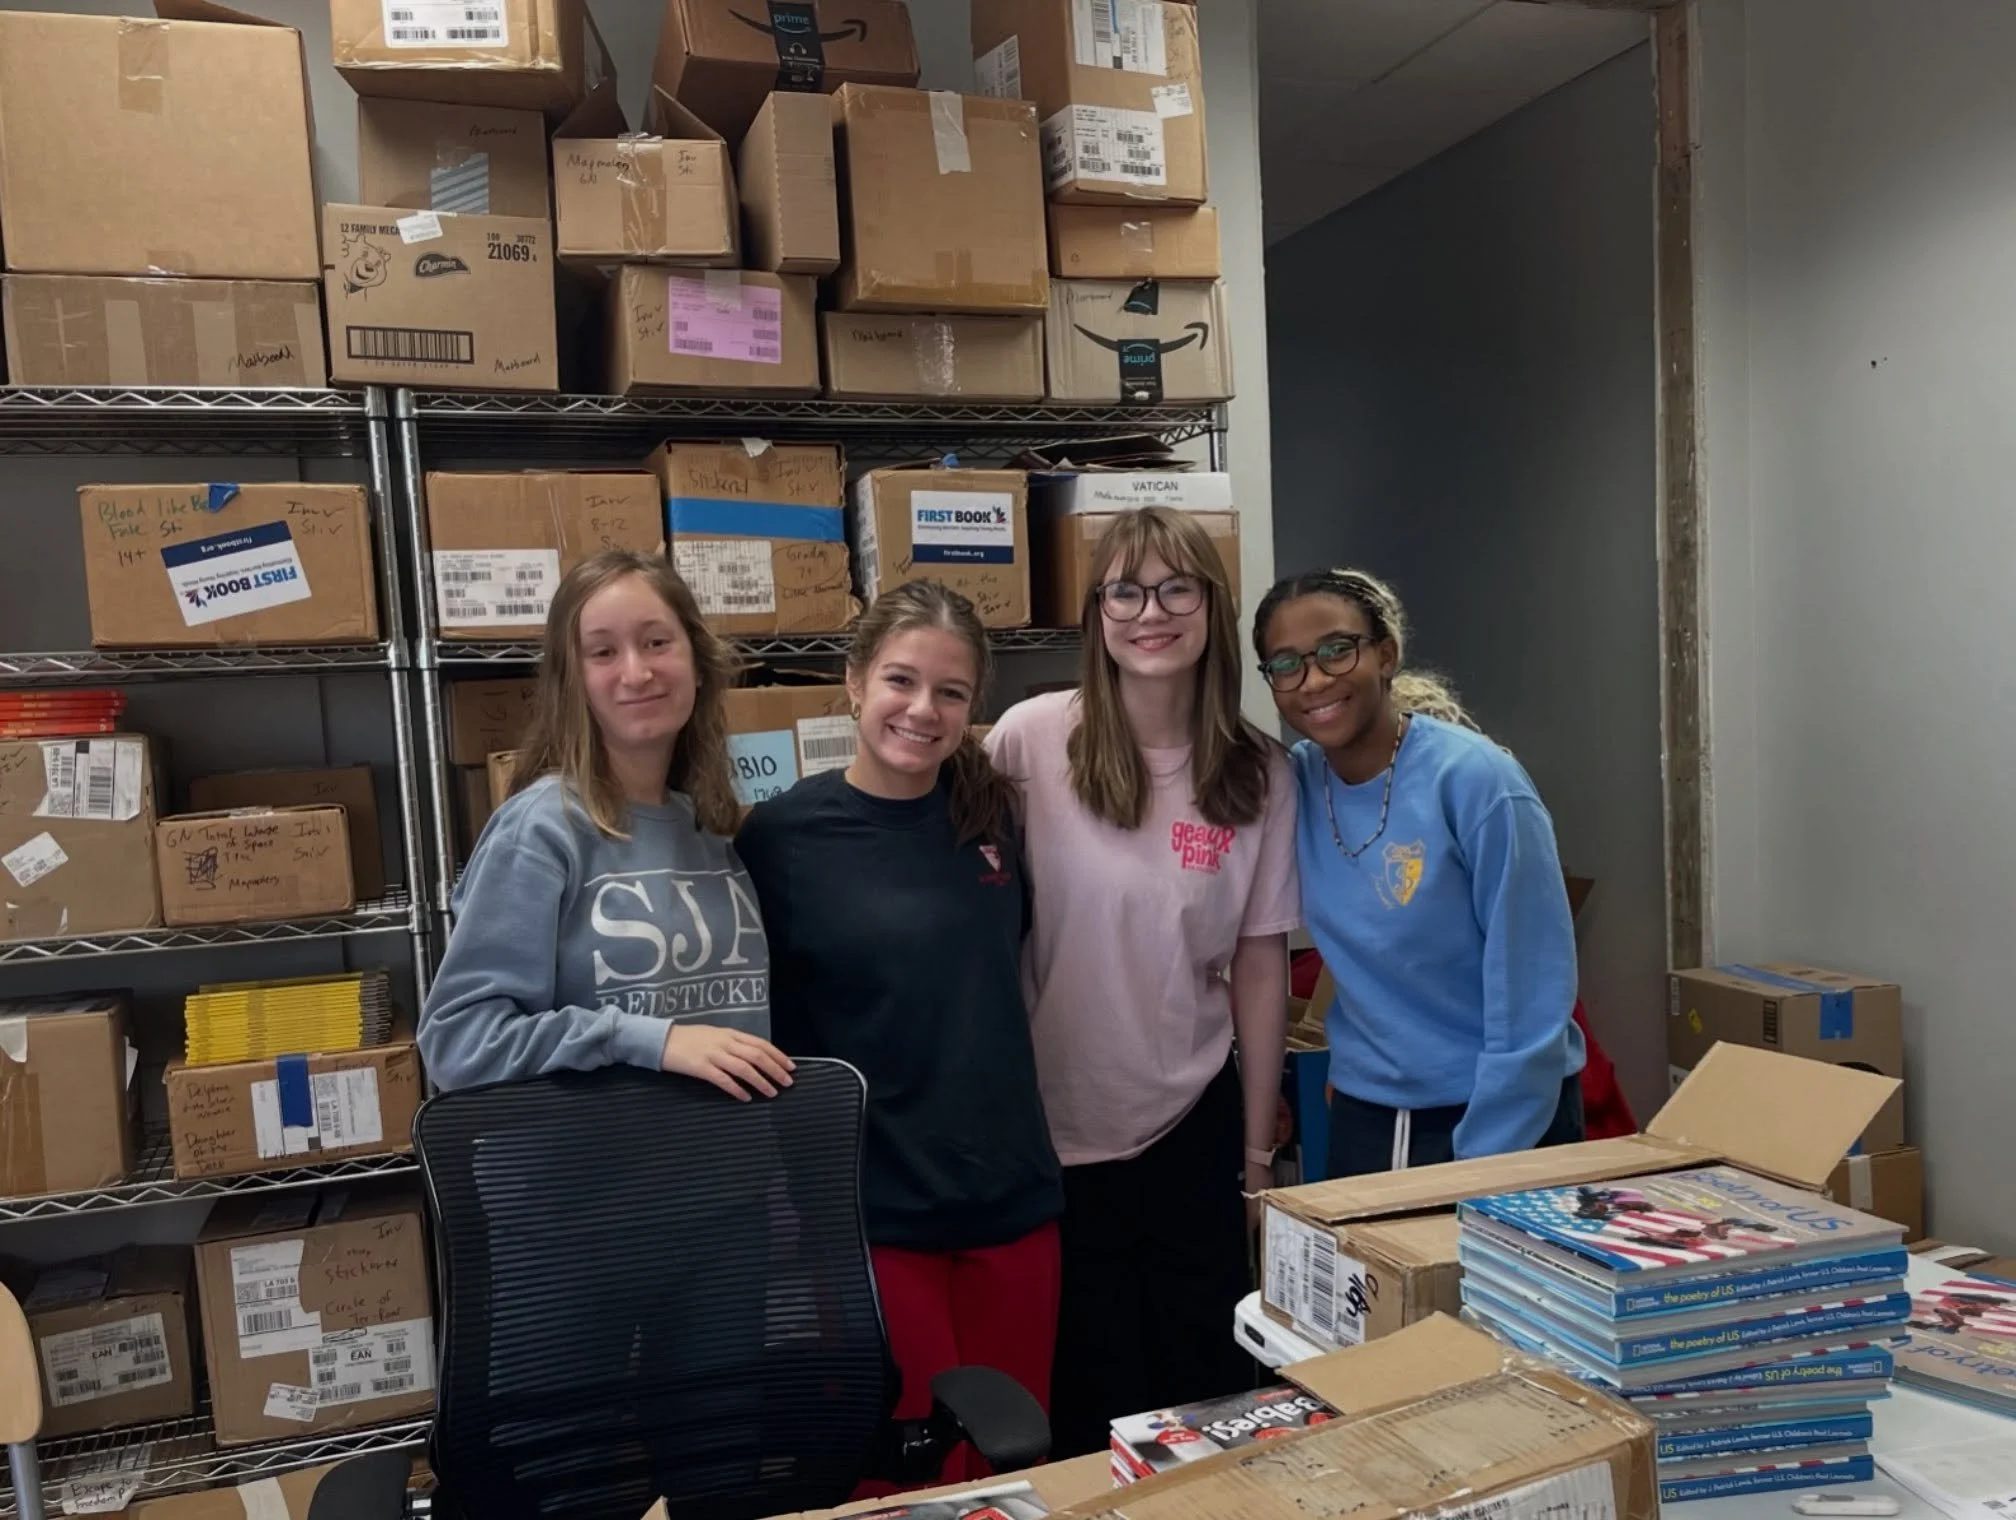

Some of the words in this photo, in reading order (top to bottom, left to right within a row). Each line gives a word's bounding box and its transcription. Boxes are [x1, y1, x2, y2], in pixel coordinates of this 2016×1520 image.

[774, 13, 809, 25] prime
[350, 224, 377, 235] FAMILY
[488, 242, 530, 262] 21069
[419, 259, 457, 274] Charmin
[1123, 352, 1156, 366] prime
[1132, 481, 1179, 492] VATICAN
[99, 500, 146, 522] Blood
[917, 509, 954, 523] FIRST
[954, 510, 992, 524] BOOK
[254, 565, 298, 589] FIRST
[203, 577, 253, 601] BOOK
[1171, 821, 1237, 853] geaux
[1182, 843, 1221, 869] pink
[590, 876, 763, 986] SJA
[1785, 1209, 1855, 1232] US
[1663, 1292, 1679, 1304] the
[1679, 1290, 1709, 1303] poetry
[1710, 1285, 1720, 1298] of
[1720, 1284, 1735, 1297] US
[1670, 1339, 1683, 1350] the
[1685, 1336, 1715, 1350] poetry
[1715, 1331, 1726, 1343] of
[1727, 1330, 1740, 1342] US
[92, 1347, 113, 1360] EAN
[350, 1350, 373, 1362] EAN
[1660, 1443, 1674, 1454] US
[1663, 1488, 1678, 1499] US
